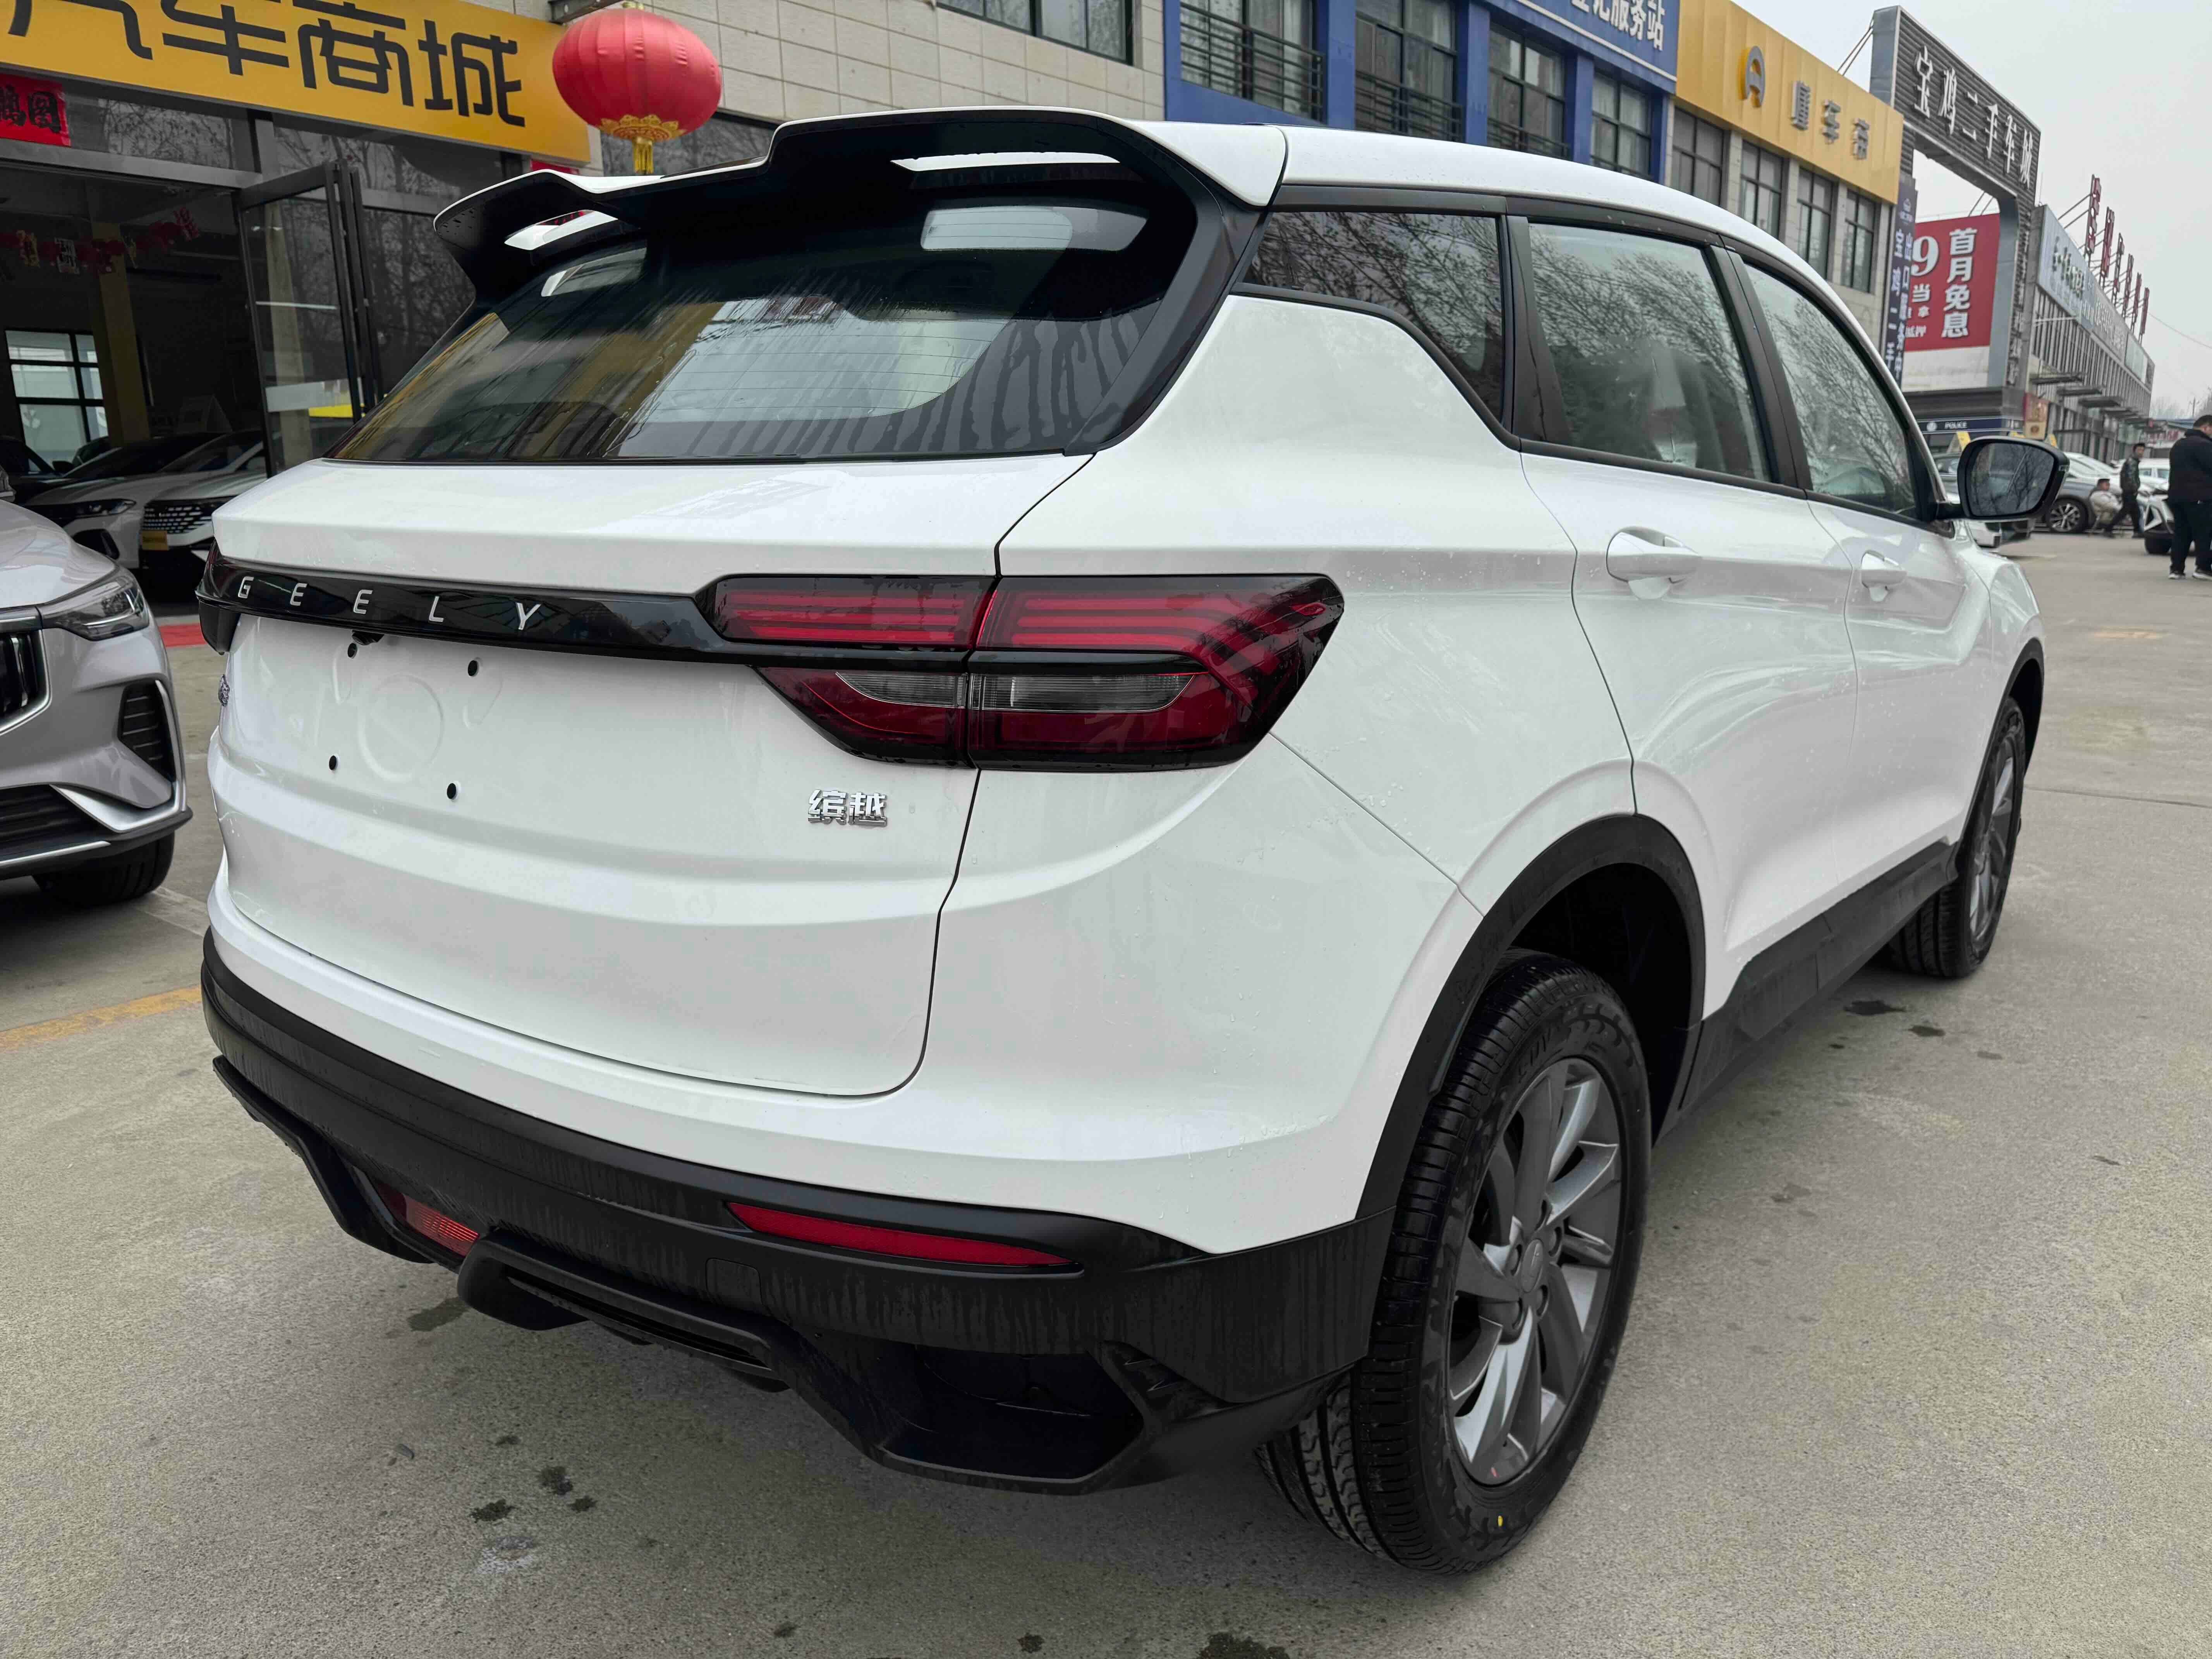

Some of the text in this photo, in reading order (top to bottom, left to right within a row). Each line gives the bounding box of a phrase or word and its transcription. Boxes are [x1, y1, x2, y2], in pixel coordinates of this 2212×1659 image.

[1571, 0, 1665, 51] 服务站
[1914, 45, 2033, 189] 宝鸡二手车城
[1941, 227, 1978, 338] 首月免息
[1944, 421, 1968, 429] POLICE
[237, 575, 541, 631] GEELY
[807, 788, 887, 827] 缤越
